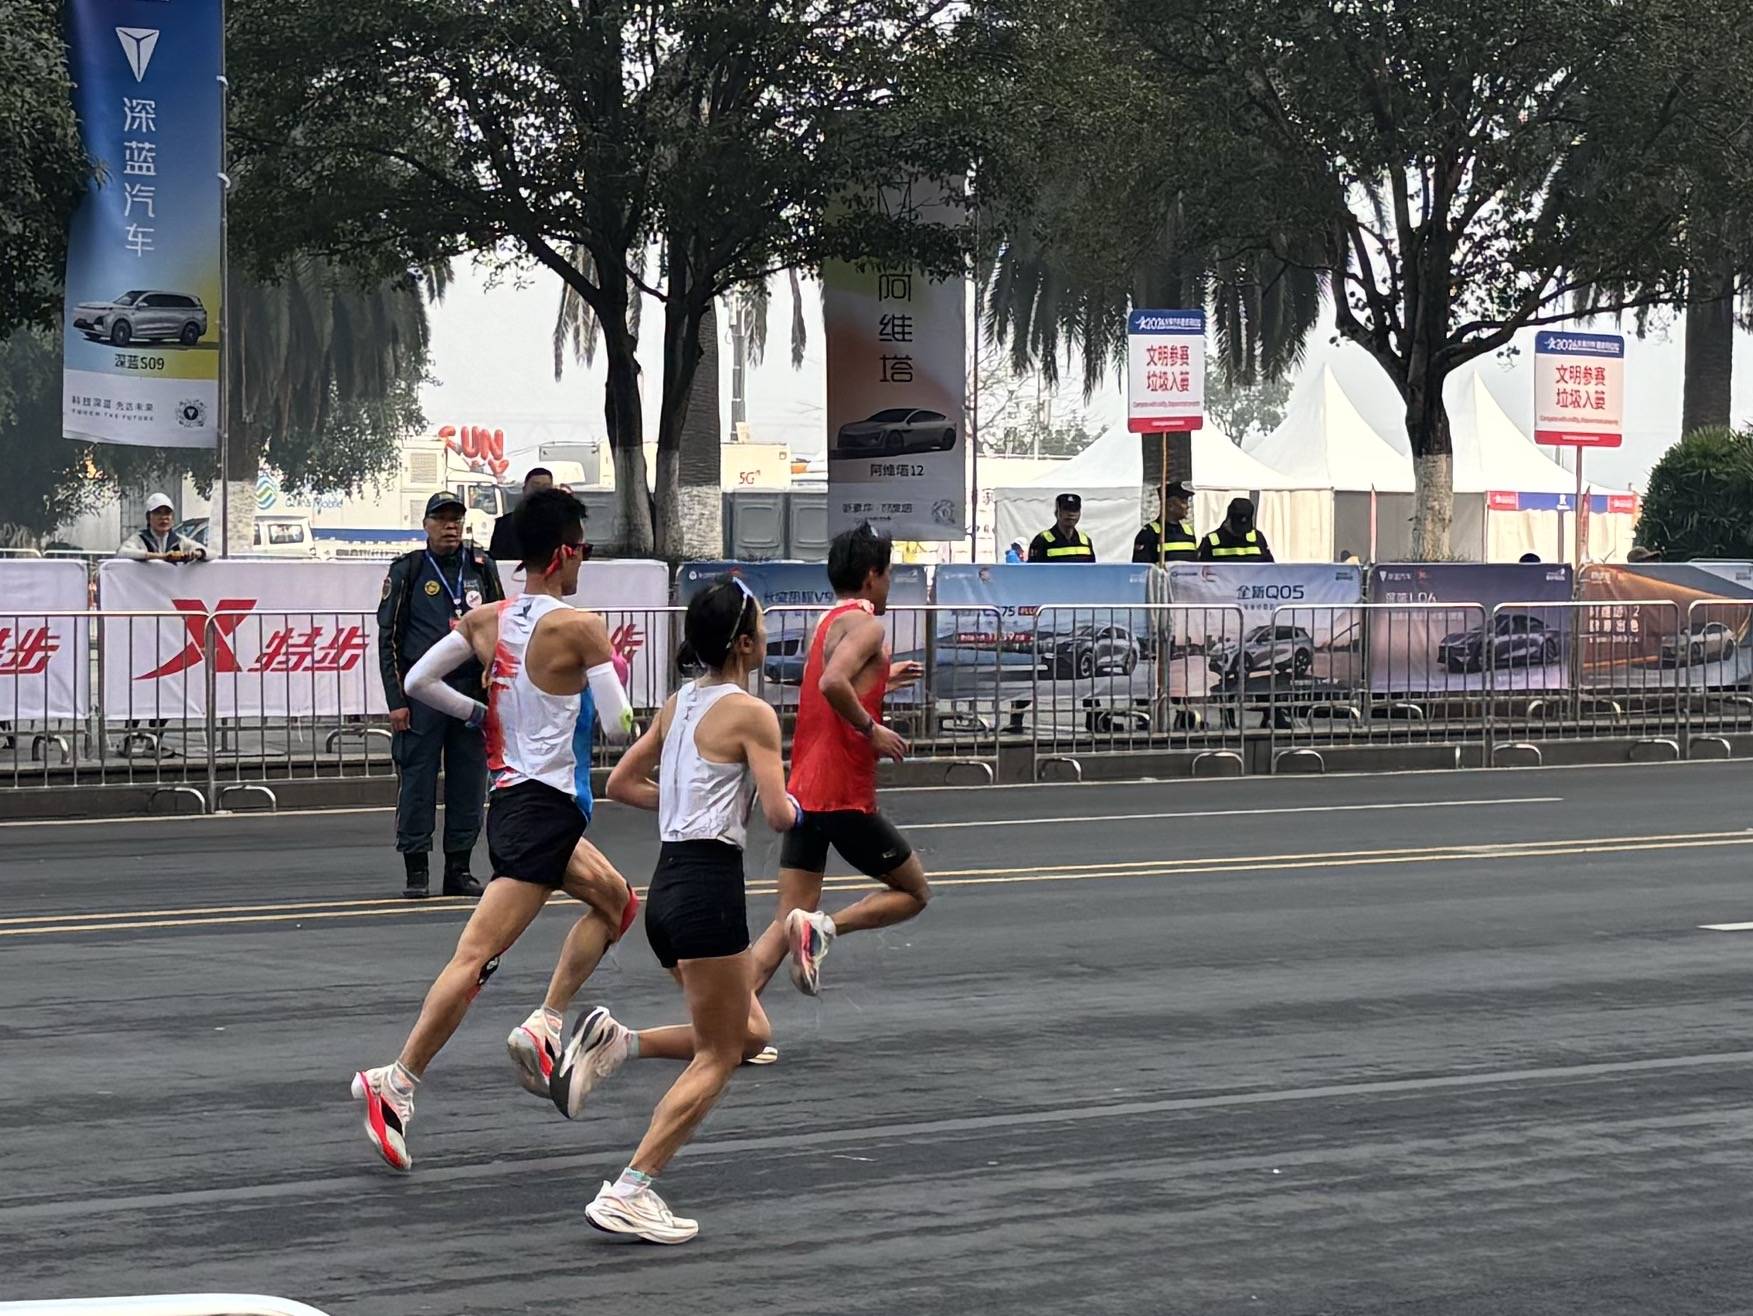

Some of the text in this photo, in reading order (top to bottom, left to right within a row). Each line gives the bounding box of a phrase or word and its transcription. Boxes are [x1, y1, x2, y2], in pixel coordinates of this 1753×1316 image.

[123, 97, 156, 257] 深蓝汽车
[878, 273, 913, 383] 阿维塔
[114, 353, 165, 370] 深蓝S09
[1146, 344, 1190, 367] 文明参赛
[1555, 364, 1606, 386] 文明参赛
[1237, 584, 1305, 600] 全新Q05
[247, 626, 371, 672] 特步
